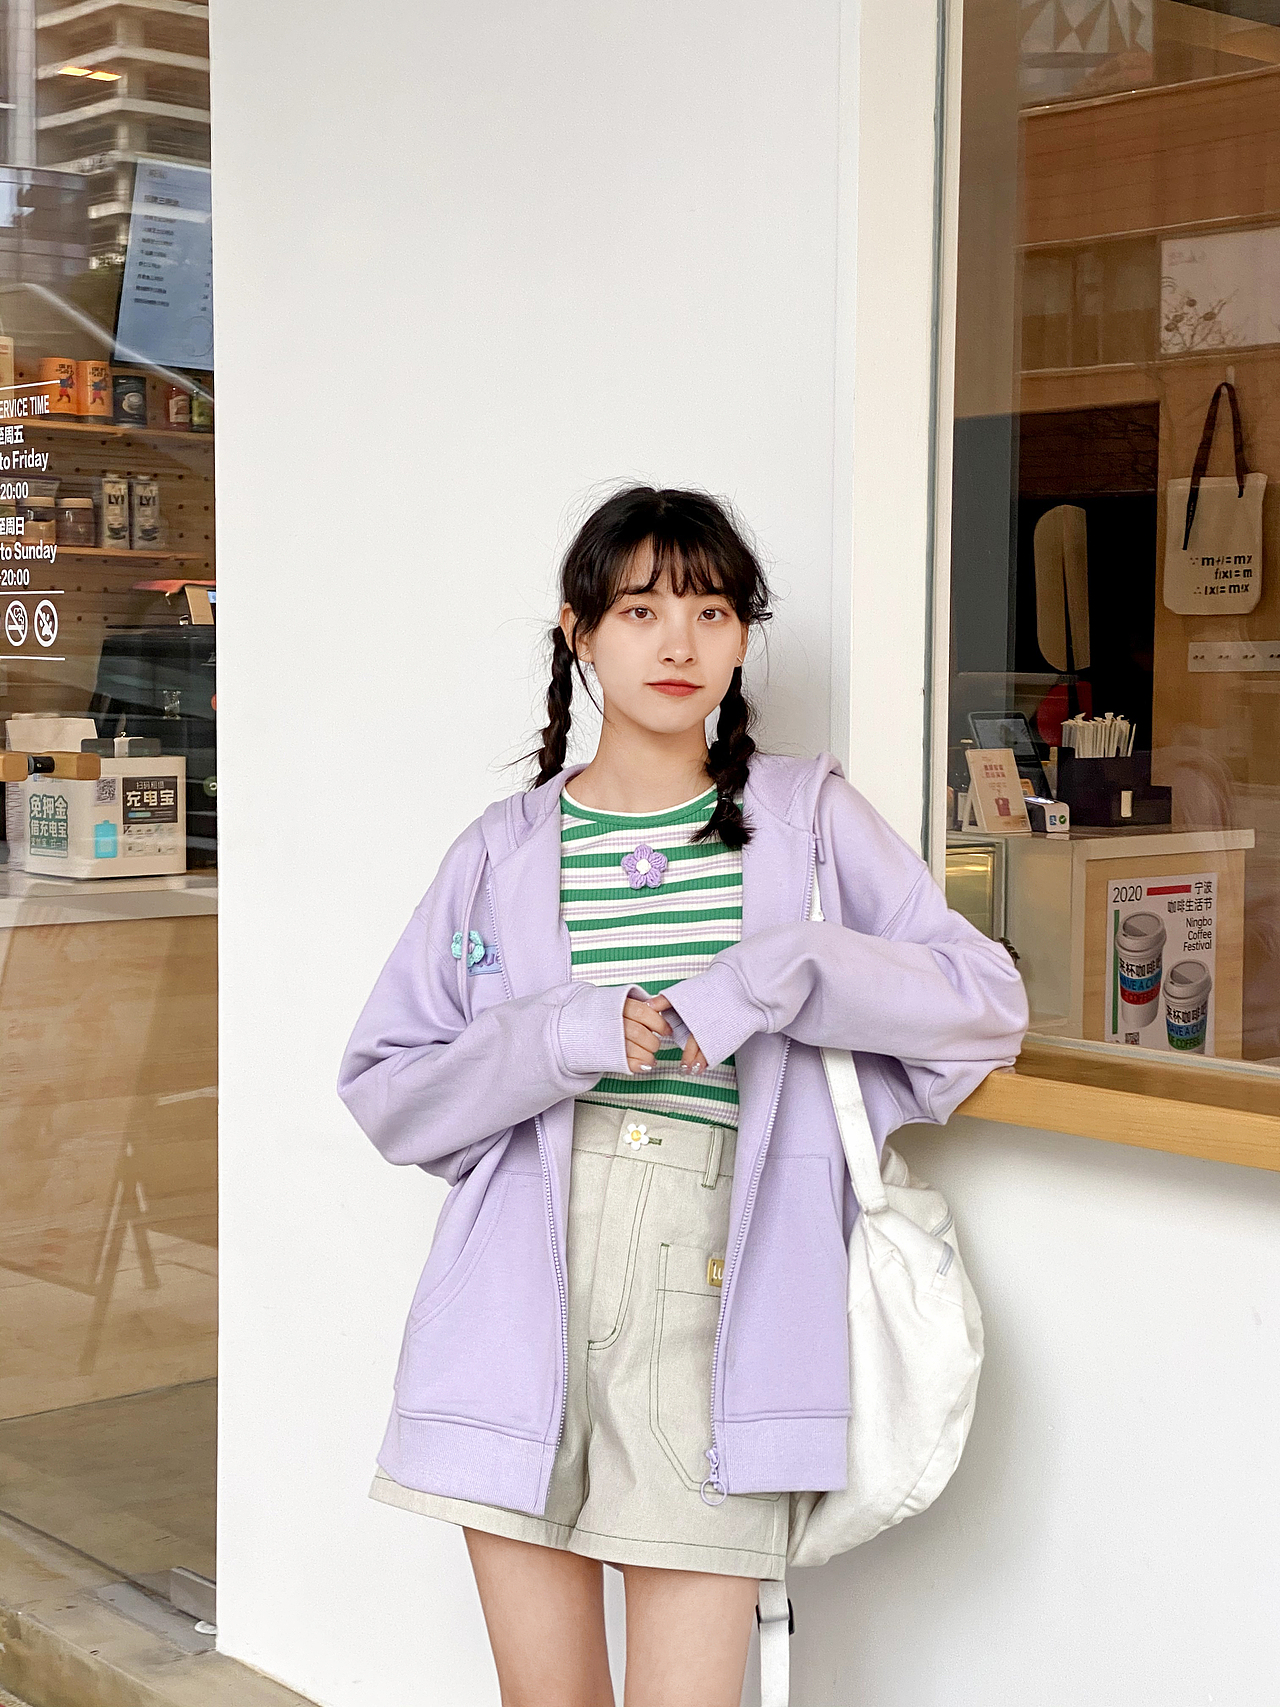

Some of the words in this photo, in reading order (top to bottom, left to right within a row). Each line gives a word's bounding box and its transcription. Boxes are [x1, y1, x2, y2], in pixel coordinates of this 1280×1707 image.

[30, 394, 50, 415] TIME
[0, 452, 10, 470] to
[12, 447, 49, 472] Friday
[0, 542, 12, 560] to
[14, 539, 57, 564] Sunday
[30, 795, 67, 819] 免押金
[126, 789, 175, 807] 充电宝
[30, 819, 67, 838] 借充电宝
[1112, 885, 1143, 903] 2020
[1194, 881, 1213, 895] 宁波
[1167, 897, 1213, 913] 咖啡生活节
[1185, 916, 1213, 930] Ningbo
[1187, 930, 1213, 941] Coffee
[1183, 940, 1213, 952] Festival
